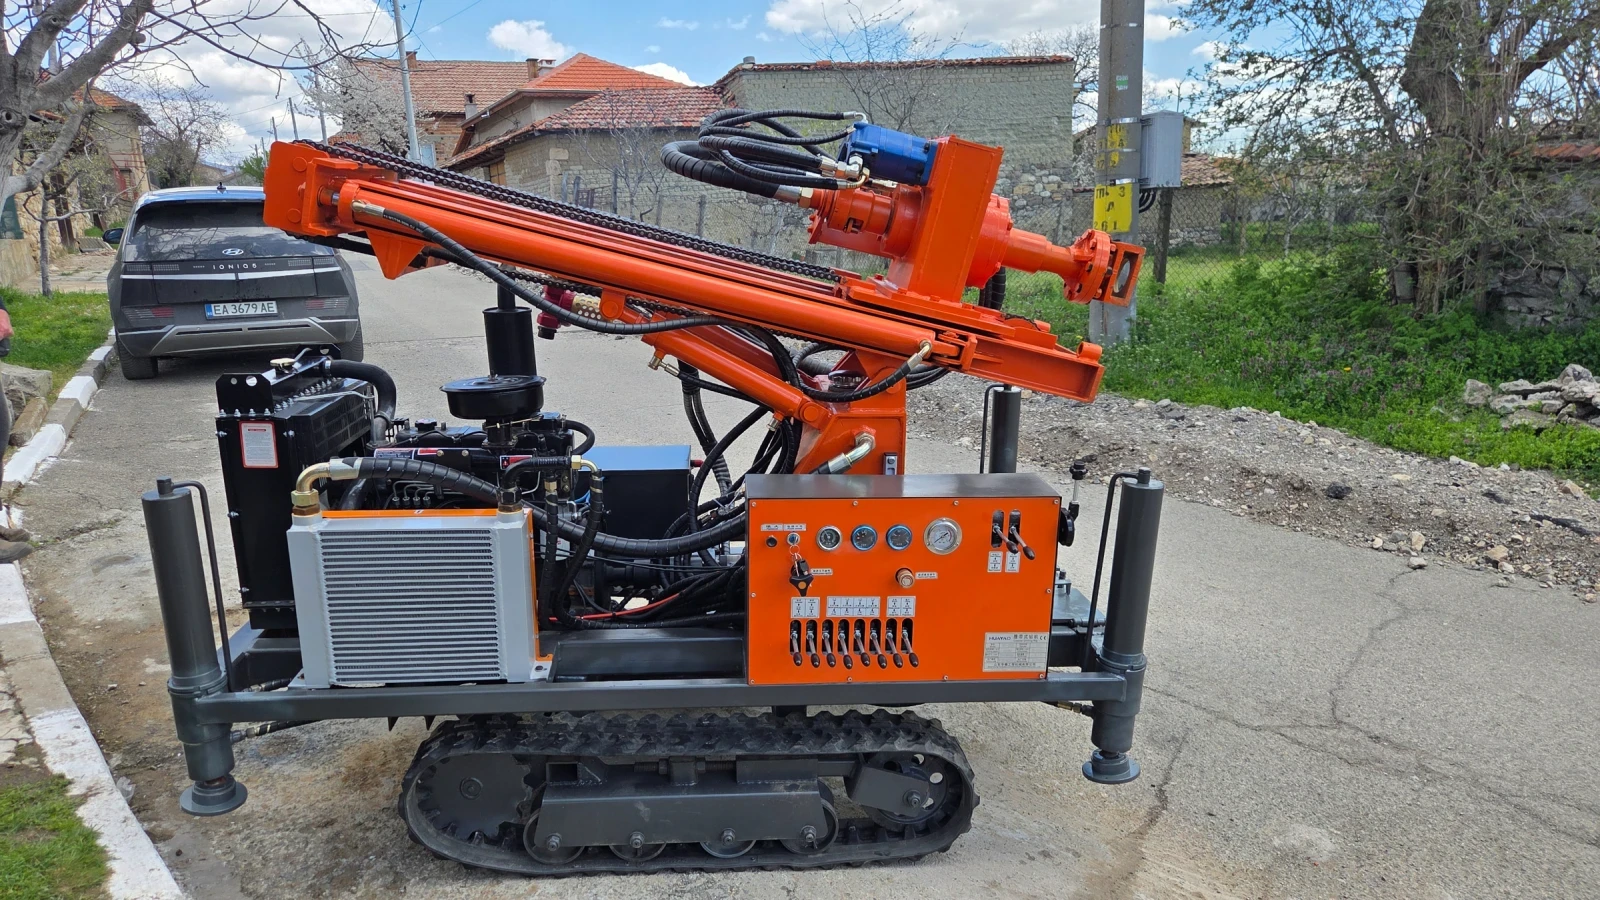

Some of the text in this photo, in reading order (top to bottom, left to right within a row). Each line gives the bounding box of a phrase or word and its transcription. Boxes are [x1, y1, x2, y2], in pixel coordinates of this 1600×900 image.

[1118, 186, 1126, 198] 3
[213, 303, 275, 315] EA 3679 AE
